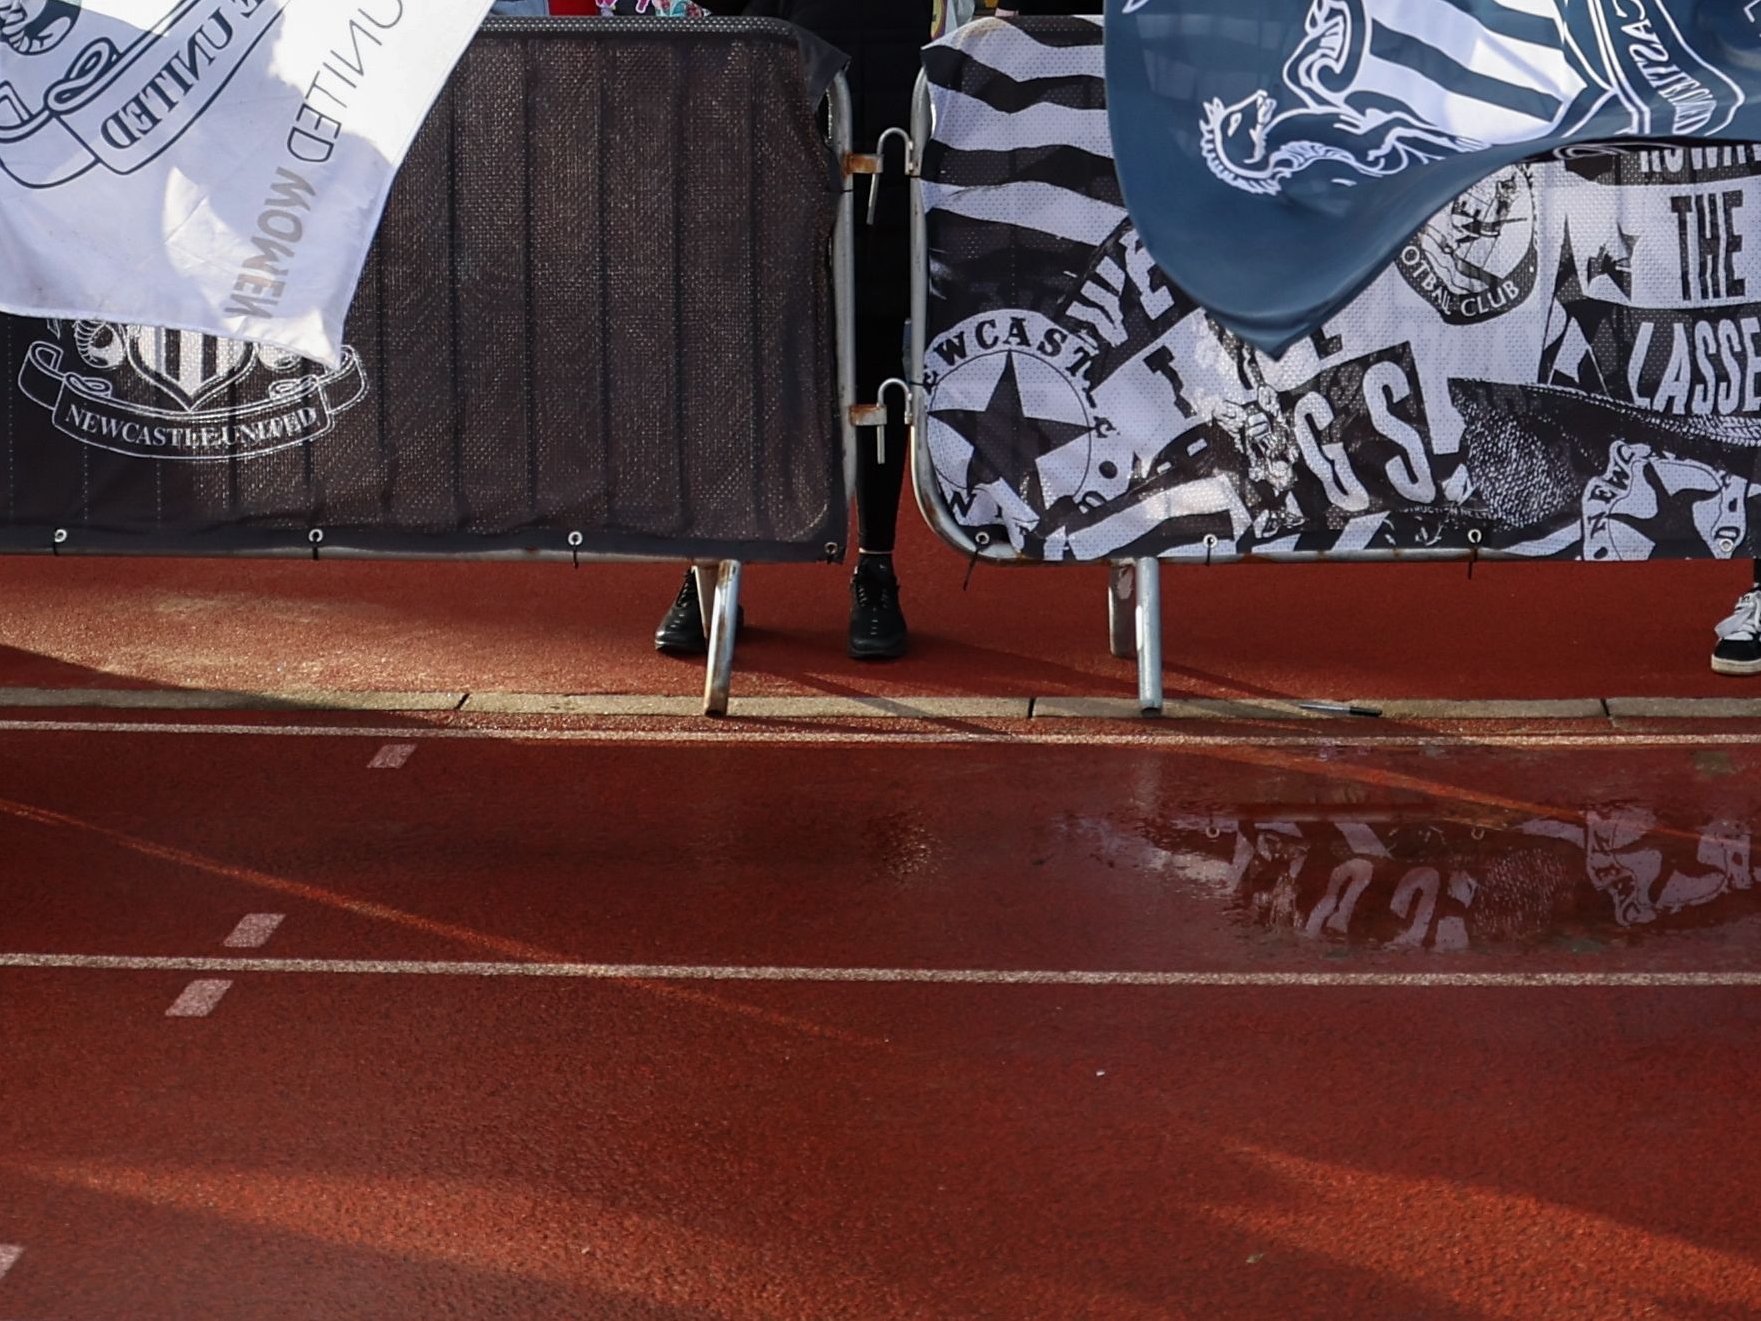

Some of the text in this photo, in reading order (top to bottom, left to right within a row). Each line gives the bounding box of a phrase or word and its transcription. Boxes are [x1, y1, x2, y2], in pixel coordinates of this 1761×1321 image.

[1399, 244, 1521, 317] OTBALL CLUB
[1669, 188, 1746, 303] THE
[64, 403, 318, 447] NEWCASTLE UNITED
